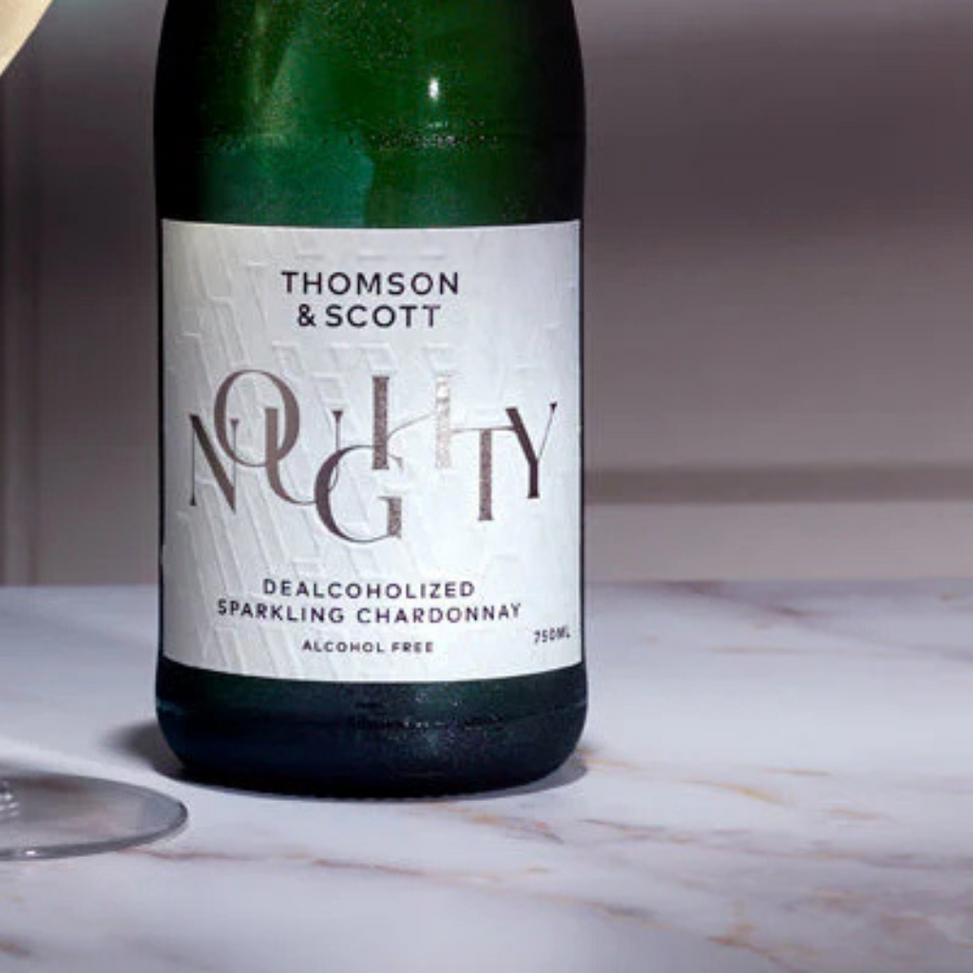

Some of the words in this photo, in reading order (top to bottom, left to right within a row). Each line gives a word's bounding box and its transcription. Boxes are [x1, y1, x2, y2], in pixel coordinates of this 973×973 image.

[281, 271, 460, 295] THOMSON
[297, 304, 316, 327] &
[326, 304, 442, 327] SCOTT
[263, 578, 476, 599] DEALCOHOLIZED
[217, 599, 345, 624] SPARKLING
[356, 602, 522, 624] CHARDONNAY
[302, 639, 385, 653] ALCOHOL
[391, 641, 434, 653] FREE
[533, 626, 572, 644] 750ML
